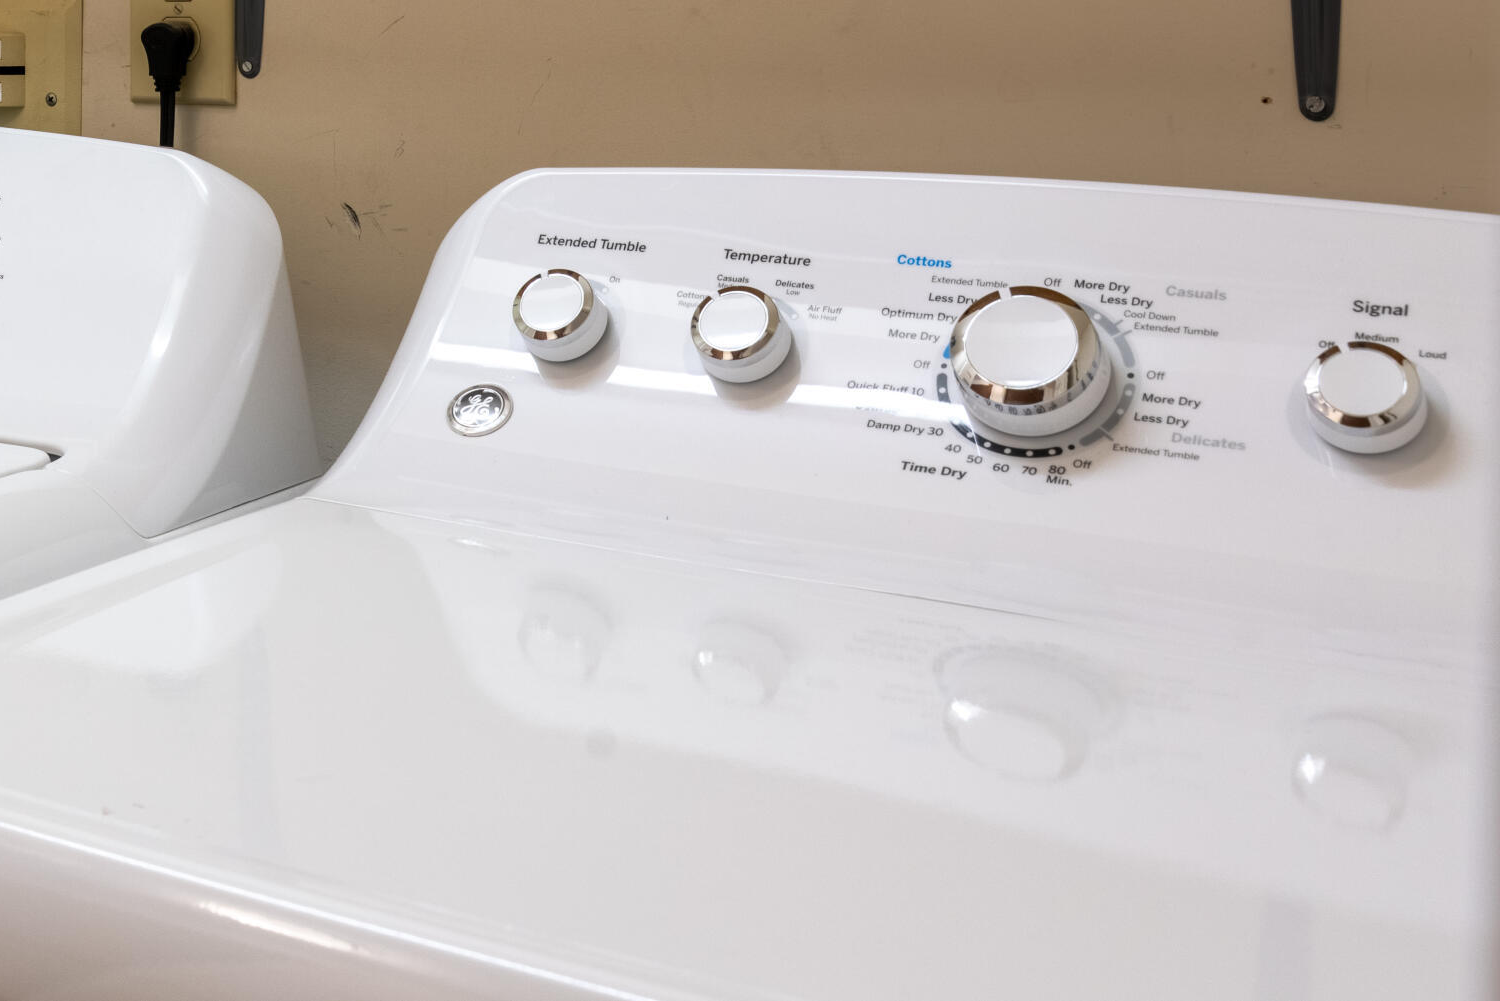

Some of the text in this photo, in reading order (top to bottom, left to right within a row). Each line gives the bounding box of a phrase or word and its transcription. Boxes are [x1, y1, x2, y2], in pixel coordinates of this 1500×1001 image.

[538, 234, 647, 253] Extended Tumble
[724, 248, 811, 267] Temperature
[897, 254, 952, 268] Cottons
[609, 275, 621, 284] On
[717, 274, 749, 283] Casuals
[931, 275, 1008, 288] Extended Tumble
[1044, 278, 1062, 287] Off
[775, 279, 815, 290] Delicates
[1074, 279, 1130, 293] More Dry
[677, 291, 709, 299] Cotton
[786, 288, 800, 296] Low
[1166, 286, 1228, 300] Casuals
[928, 293, 979, 305] Less Dry
[1100, 295, 1153, 309] Less Dry
[807, 304, 843, 315] Air Fluff
[1352, 299, 1409, 317] Signal
[819, 314, 838, 322] Heat
[881, 308, 958, 324] Optimum Dry
[1123, 310, 1176, 321] Cool Down
[1134, 322, 1219, 337] Extended Tumble
[888, 329, 941, 344] More Dry
[1355, 332, 1399, 343] Medium
[1319, 340, 1335, 349] Off
[1419, 350, 1447, 360] Loud
[913, 359, 931, 369] Off
[1146, 370, 1166, 380] Off
[912, 387, 925, 396] 10
[1142, 393, 1201, 409] More Dry
[1134, 412, 1189, 427] Less Dry
[867, 419, 944, 436] Damp Dry 30
[1171, 432, 1246, 450] Delicates
[944, 444, 962, 454] 40
[1112, 443, 1200, 461] Extended Tumble
[966, 455, 983, 464] 50
[1073, 459, 1092, 469] Off
[901, 461, 967, 480] Time Dry
[993, 463, 1010, 473] 60
[1022, 466, 1037, 476] 70
[1048, 465, 1066, 475] 80
[1046, 475, 1073, 486] Min.
